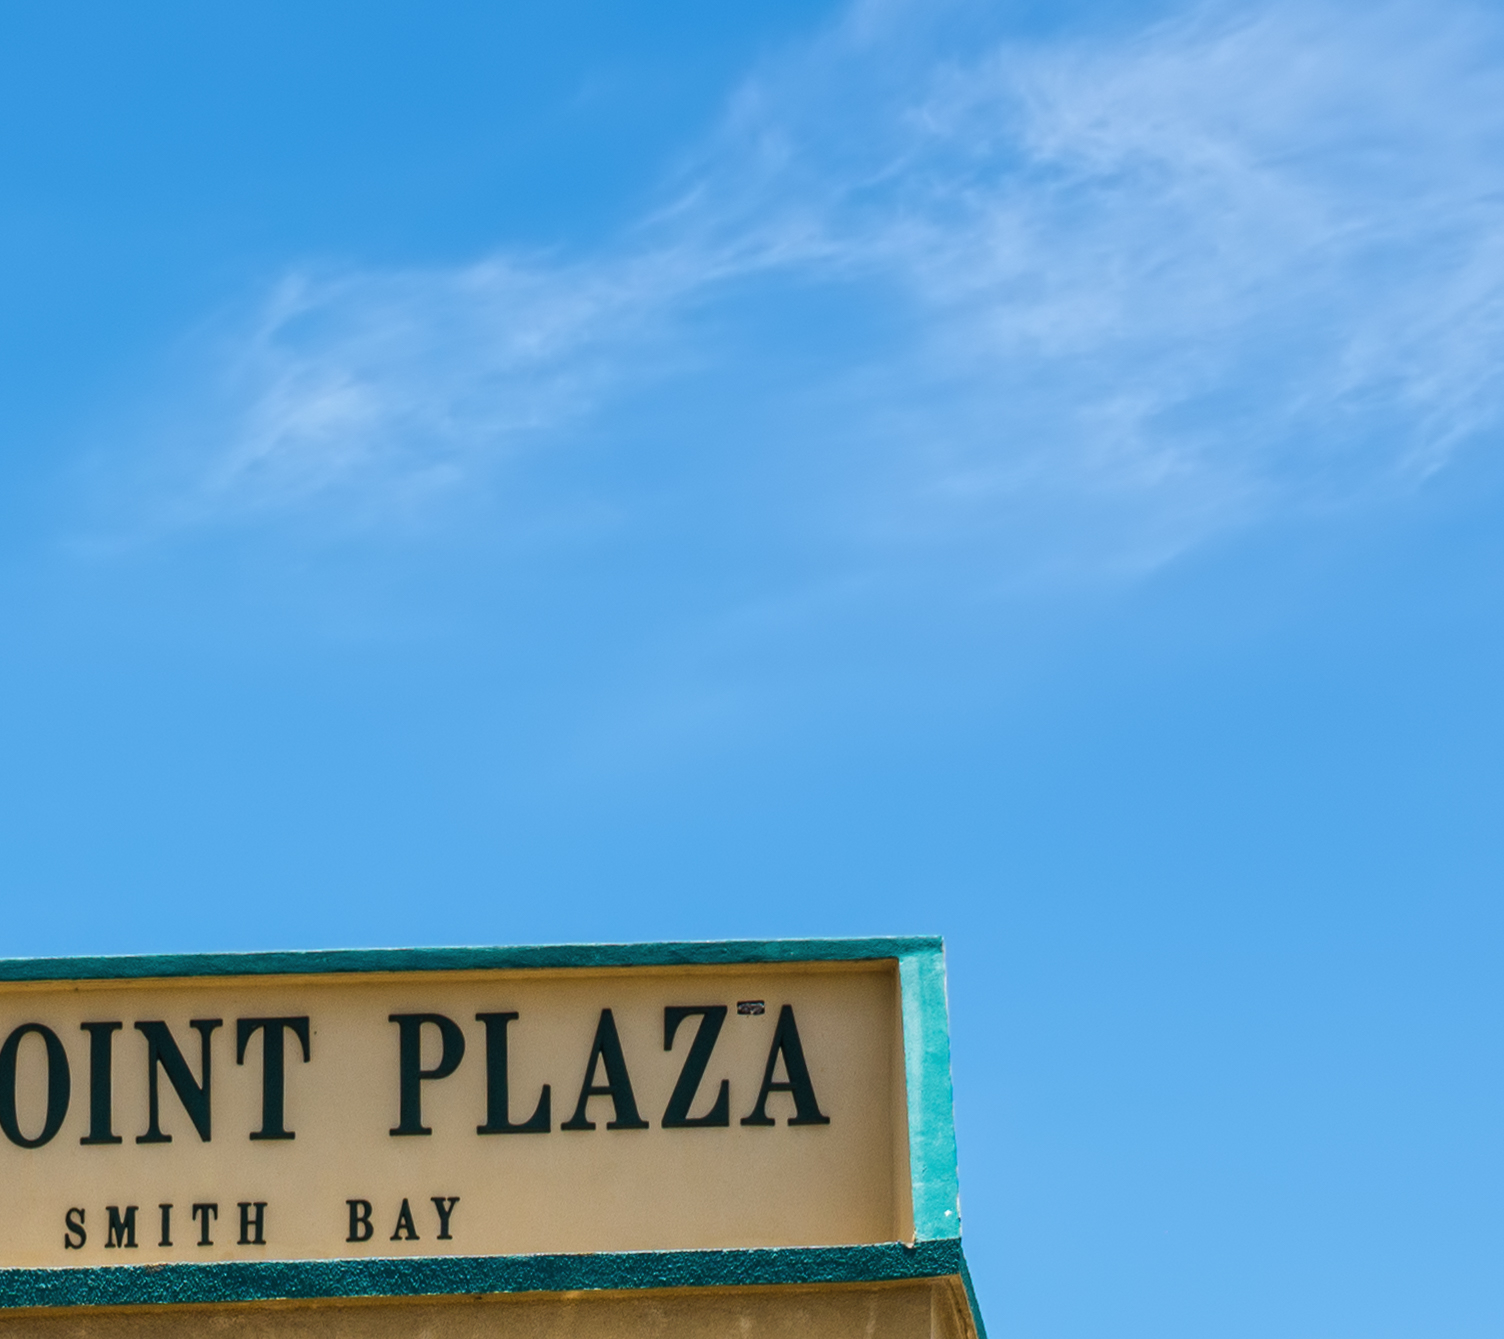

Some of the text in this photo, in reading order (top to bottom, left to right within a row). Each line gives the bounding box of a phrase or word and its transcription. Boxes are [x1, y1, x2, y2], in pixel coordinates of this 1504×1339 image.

[387, 1003, 831, 1138] PLAZA
[63, 1199, 269, 1250] SMITH
[346, 1194, 462, 1244] BAY
